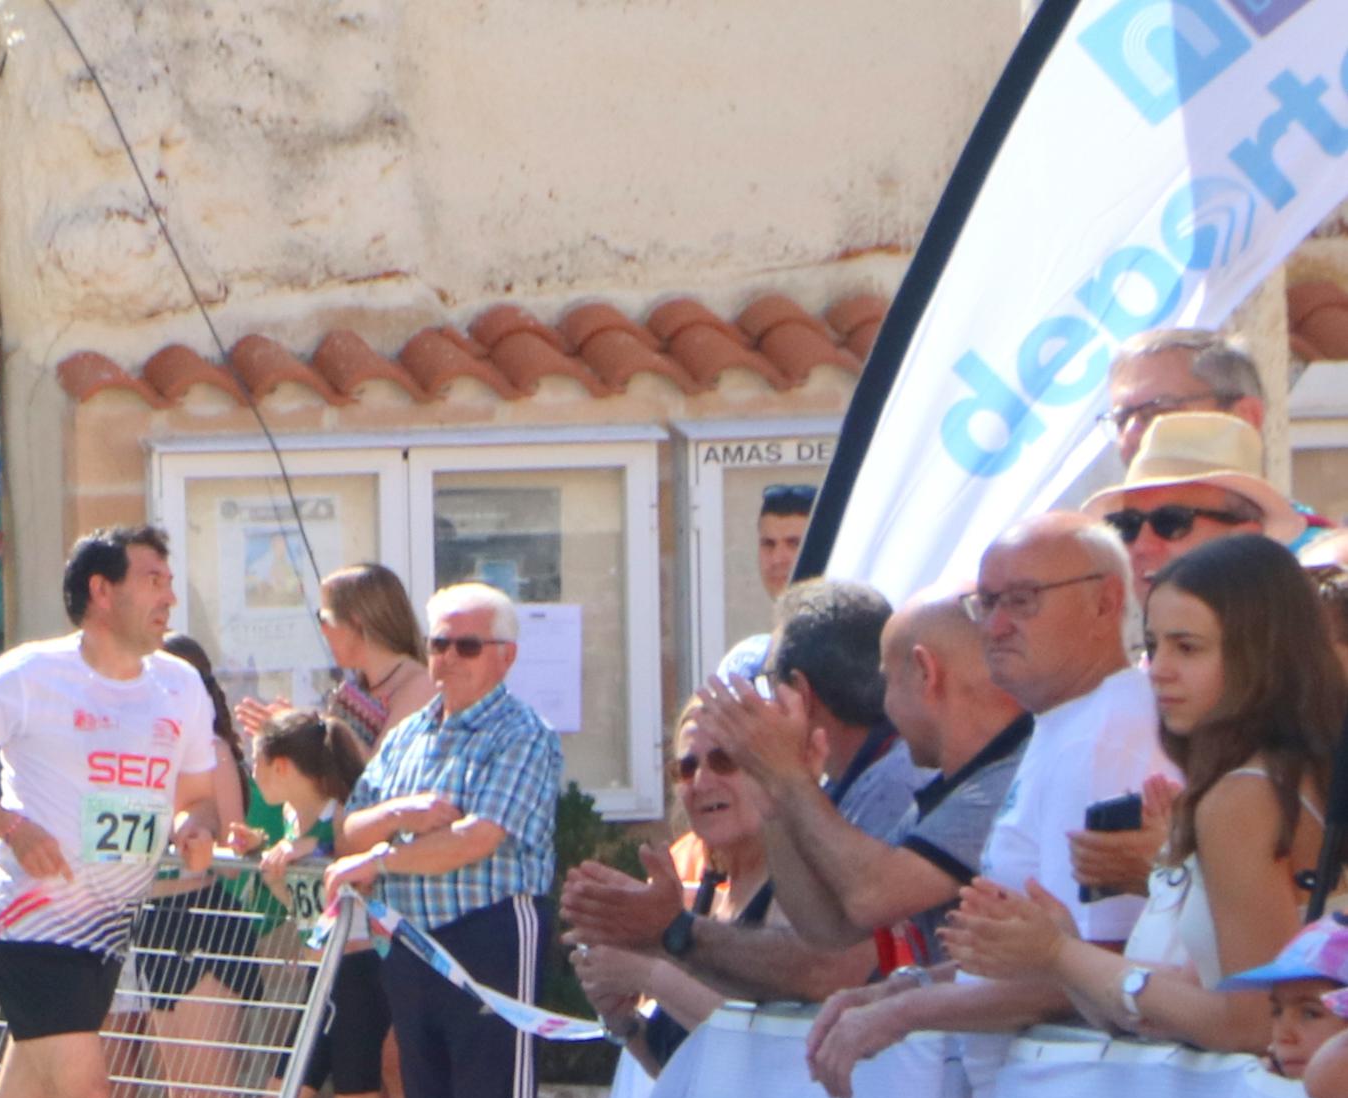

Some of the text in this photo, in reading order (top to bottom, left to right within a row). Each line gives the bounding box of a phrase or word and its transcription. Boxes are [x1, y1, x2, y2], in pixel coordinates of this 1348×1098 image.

[941, 43, 1348, 478] deport
[704, 443, 783, 465] AMAS
[88, 751, 171, 789] SER
[96, 812, 156, 853] 271
